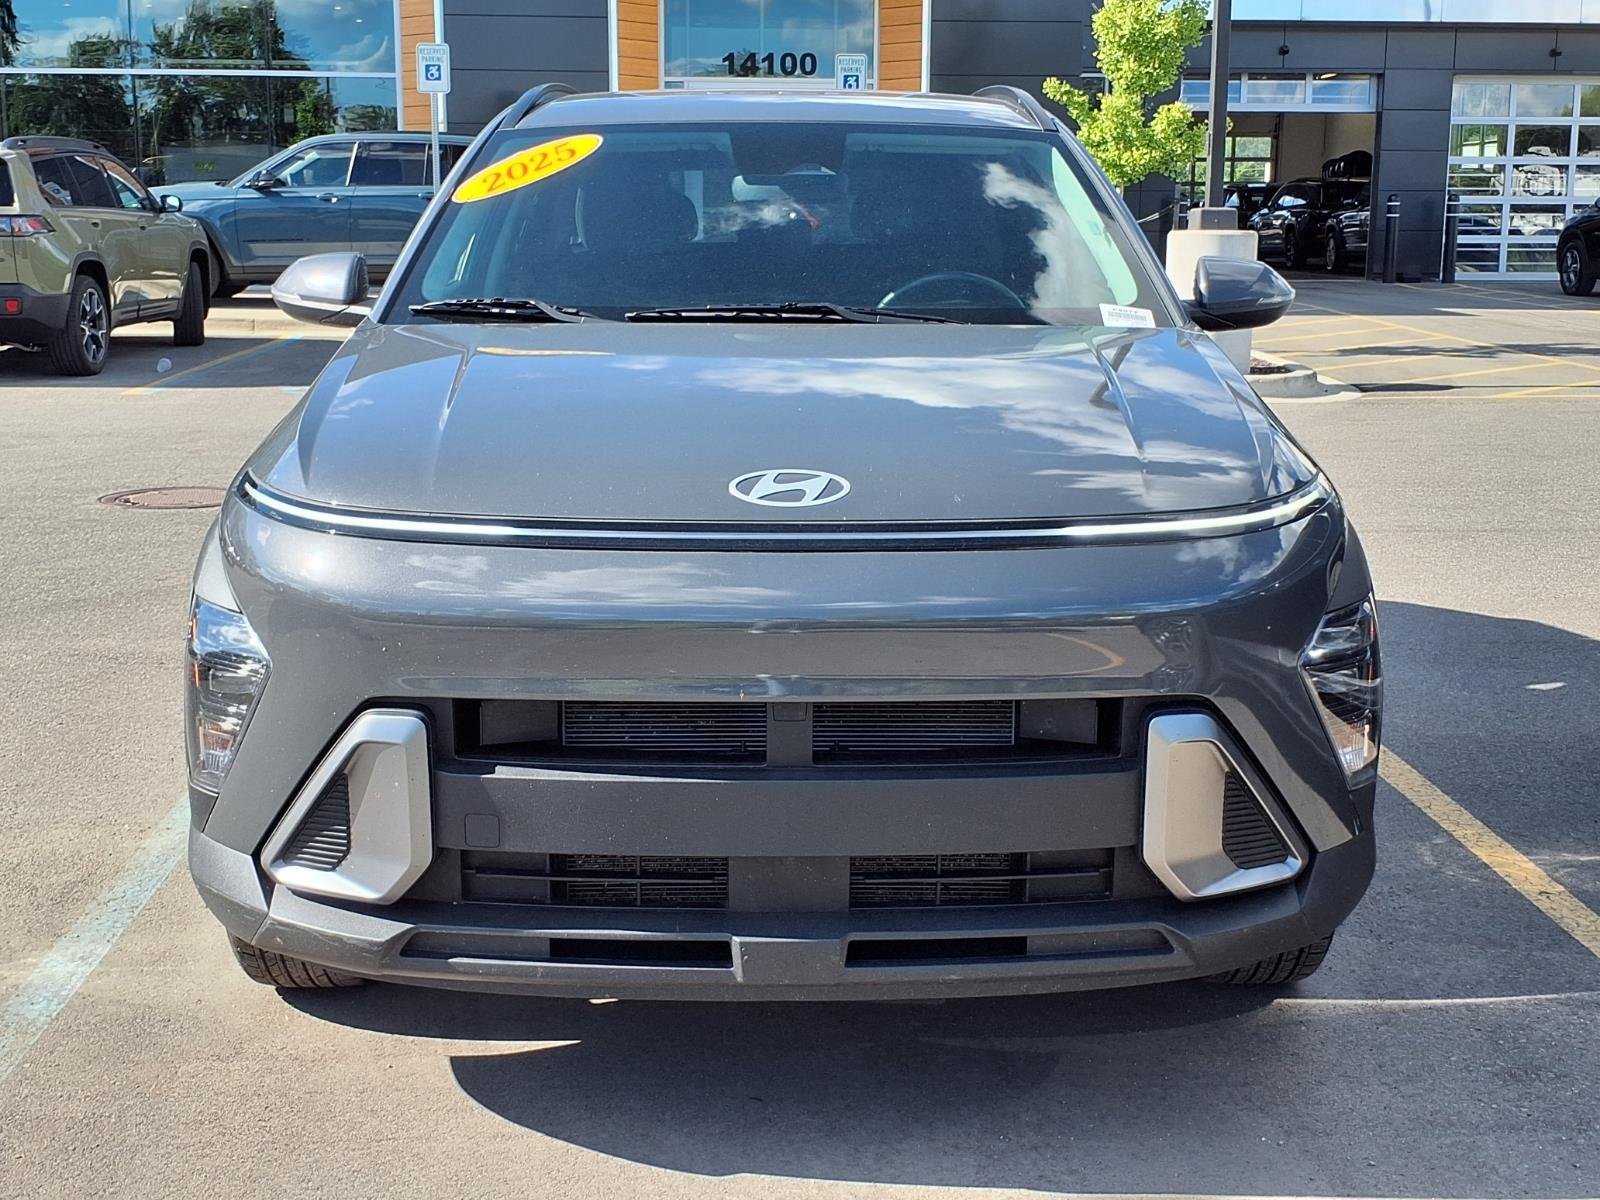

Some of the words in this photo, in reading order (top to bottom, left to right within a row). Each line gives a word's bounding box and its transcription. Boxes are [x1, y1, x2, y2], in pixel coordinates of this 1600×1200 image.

[419, 47, 446, 55] RESERVED
[421, 55, 444, 63] PARKING
[838, 58, 864, 66] RESERVED
[722, 52, 817, 75] 14100
[840, 66, 862, 74] PARKING
[482, 142, 576, 193] 2025
